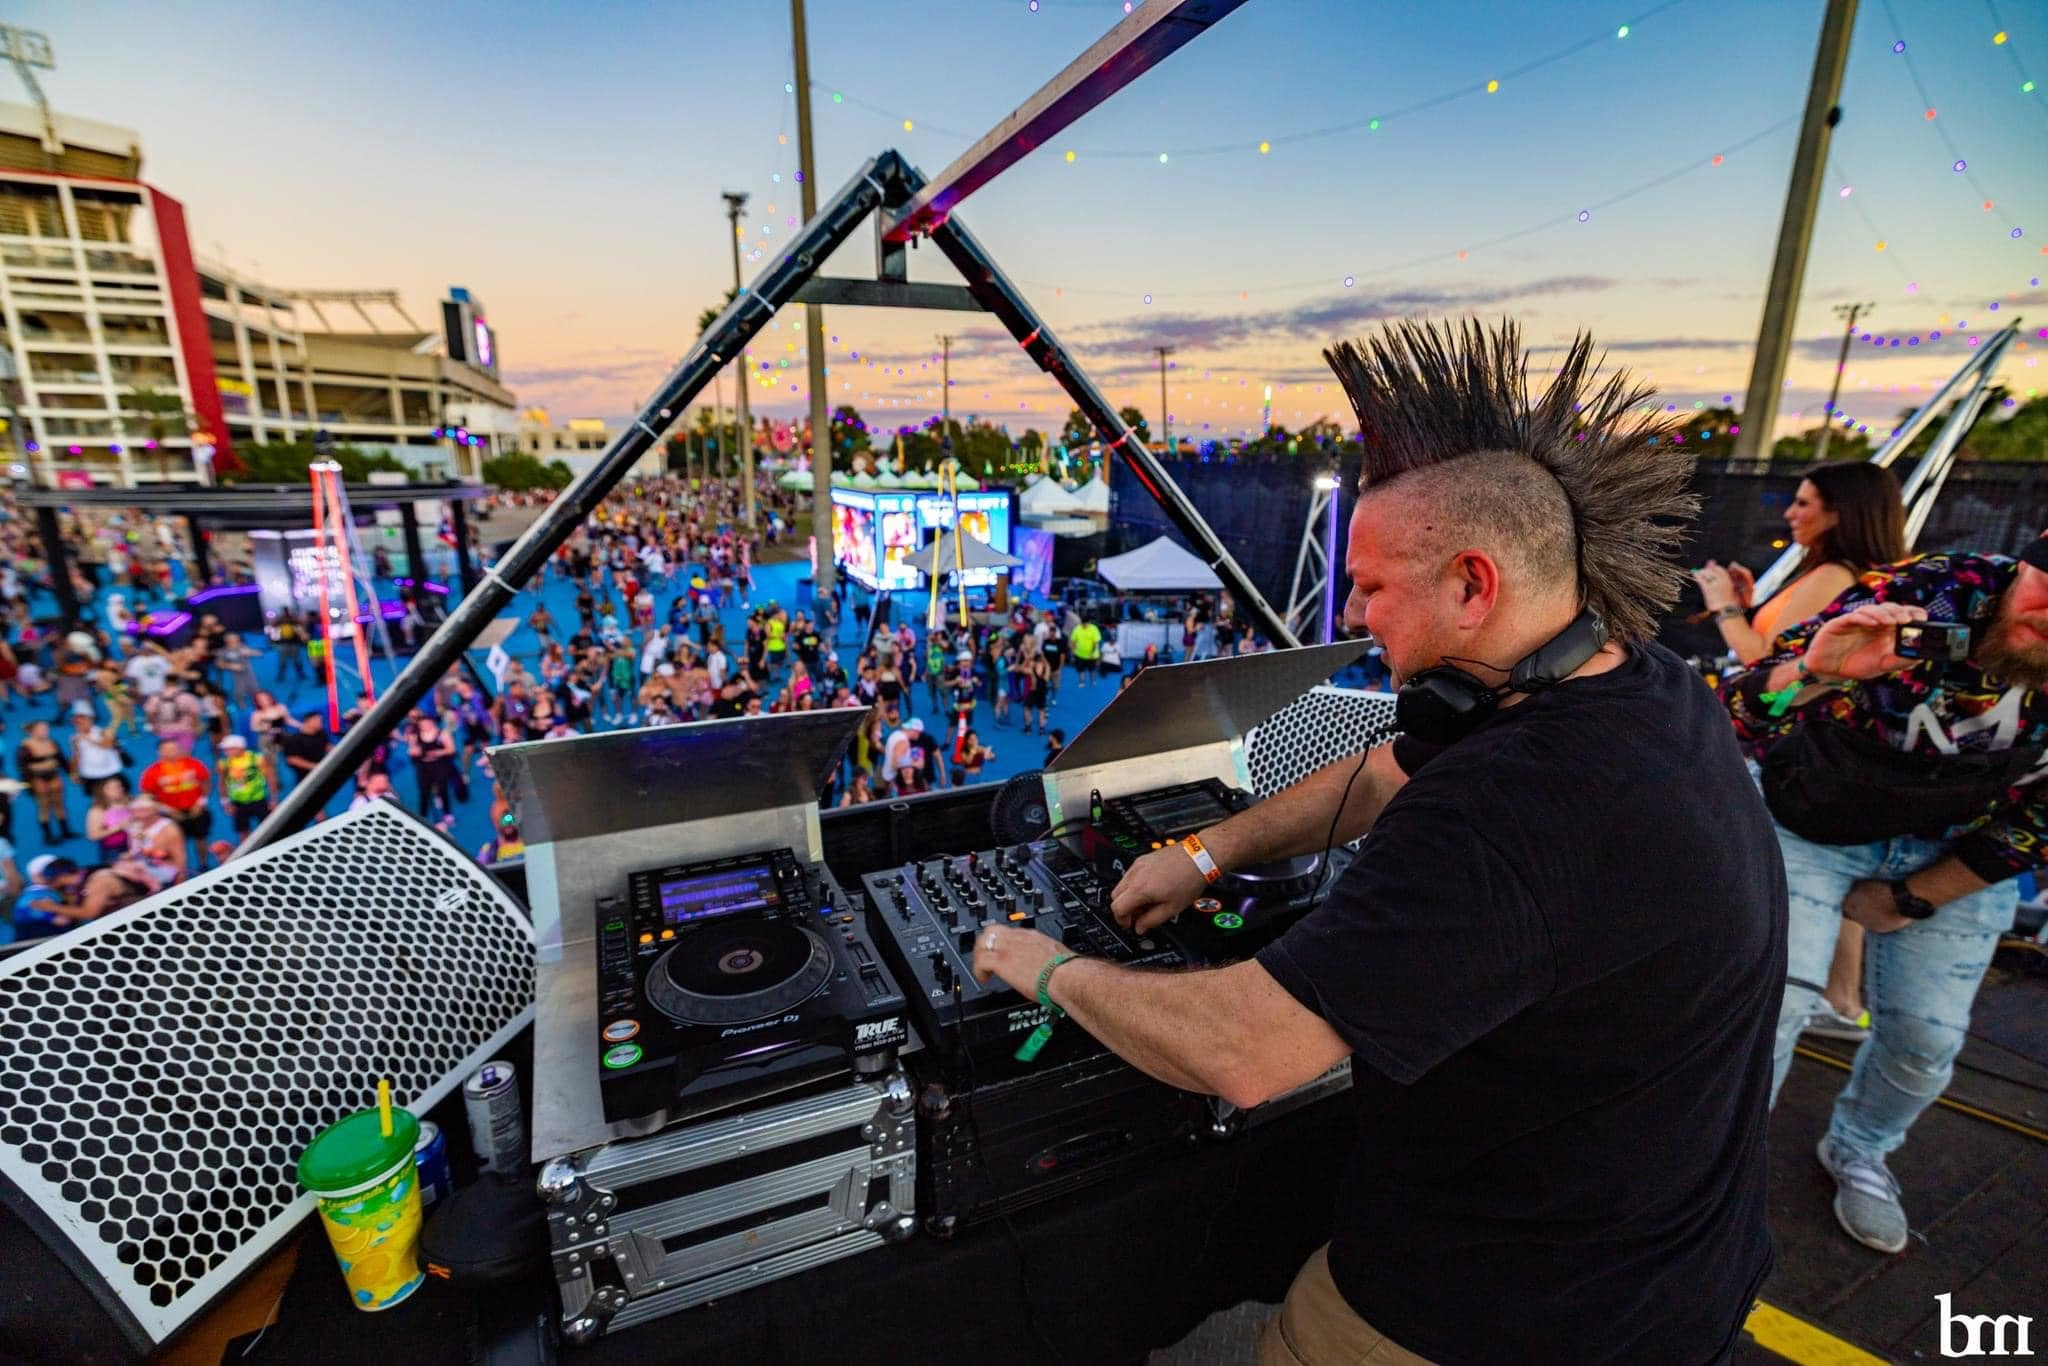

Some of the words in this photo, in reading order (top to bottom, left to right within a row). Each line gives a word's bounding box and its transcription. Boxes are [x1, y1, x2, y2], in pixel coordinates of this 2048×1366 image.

[720, 1018, 780, 1038] Pioneer
[783, 1014, 800, 1023] DJ
[855, 1016, 900, 1041] TRUE
